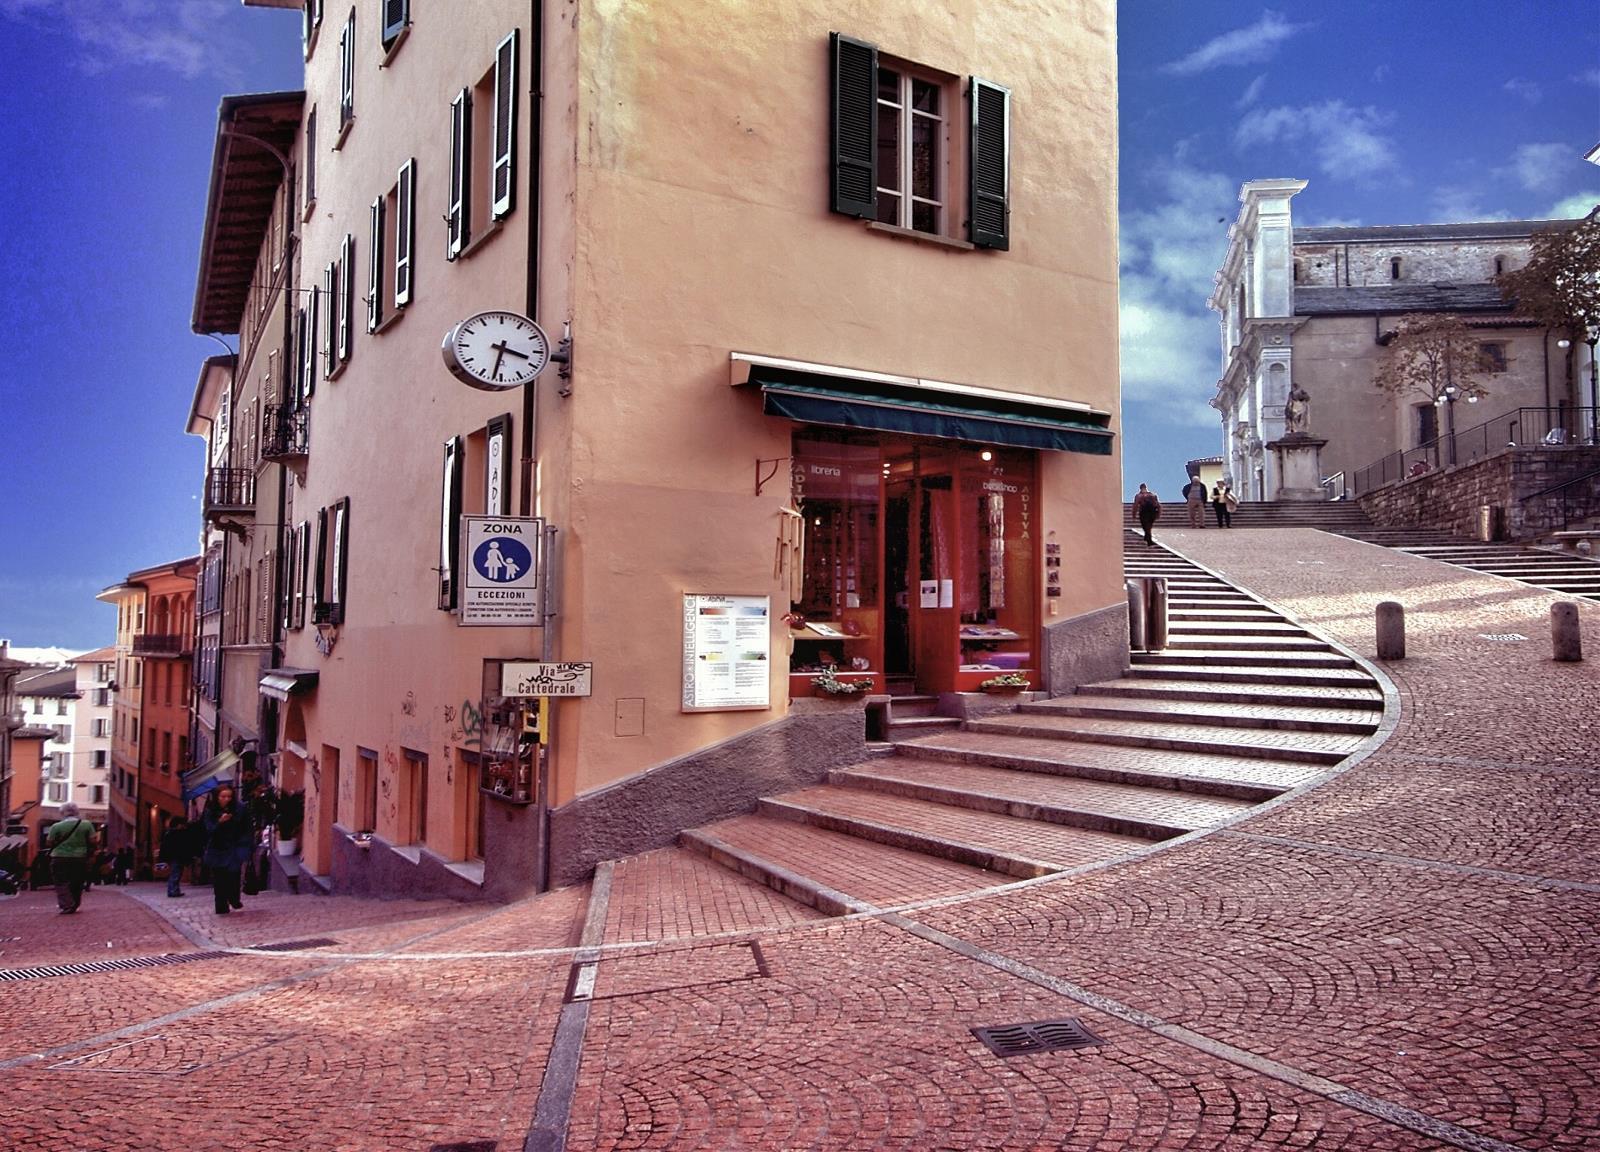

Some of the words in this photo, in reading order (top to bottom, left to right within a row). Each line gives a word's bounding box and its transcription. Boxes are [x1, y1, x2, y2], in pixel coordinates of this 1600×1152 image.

[810, 464, 841, 477] libreria
[483, 523, 522, 534] ZONA
[478, 591, 525, 599] ECCEZIONI
[539, 665, 555, 676] Via
[518, 682, 576, 694] Cattedrale
